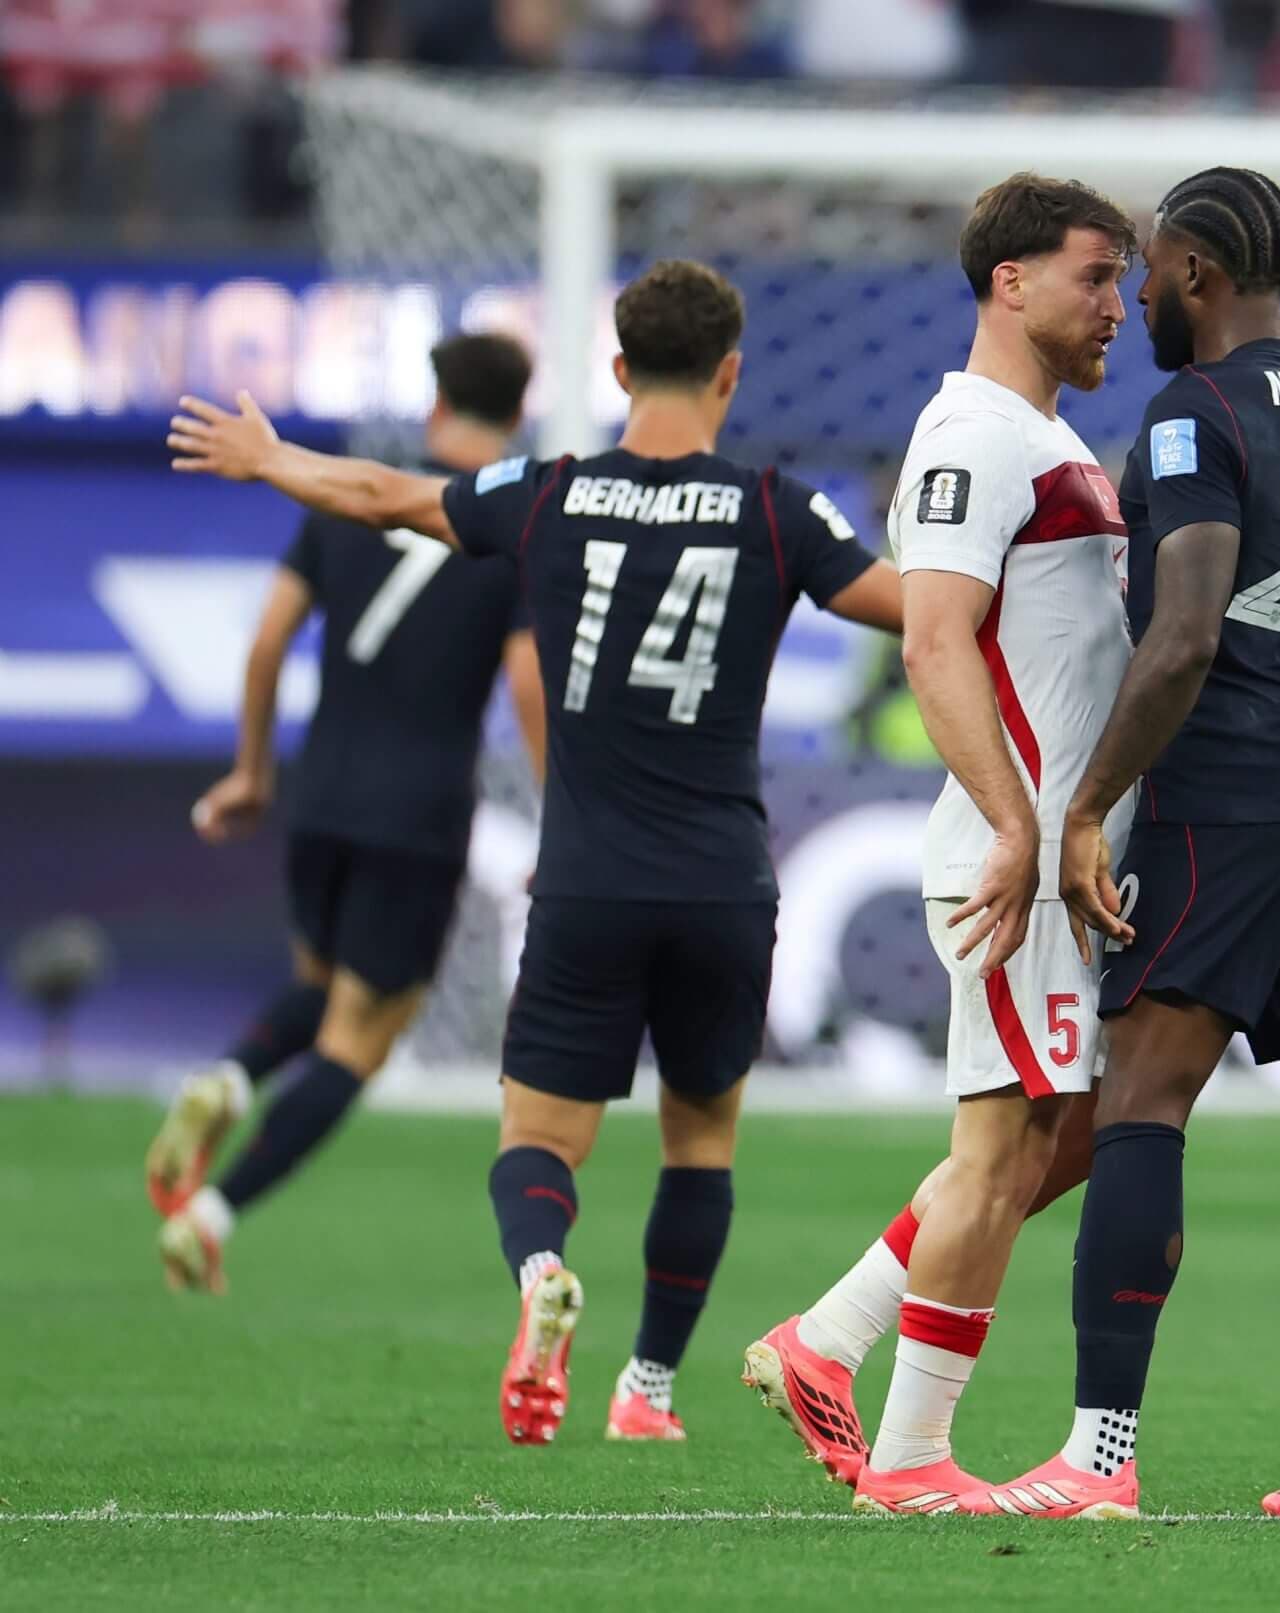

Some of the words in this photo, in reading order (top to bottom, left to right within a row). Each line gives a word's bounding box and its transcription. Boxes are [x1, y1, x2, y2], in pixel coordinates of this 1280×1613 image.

[562, 475, 744, 525] BERHALTER
[346, 527, 453, 666] 7
[562, 538, 740, 725] 14
[1046, 992, 1080, 1068] 5
